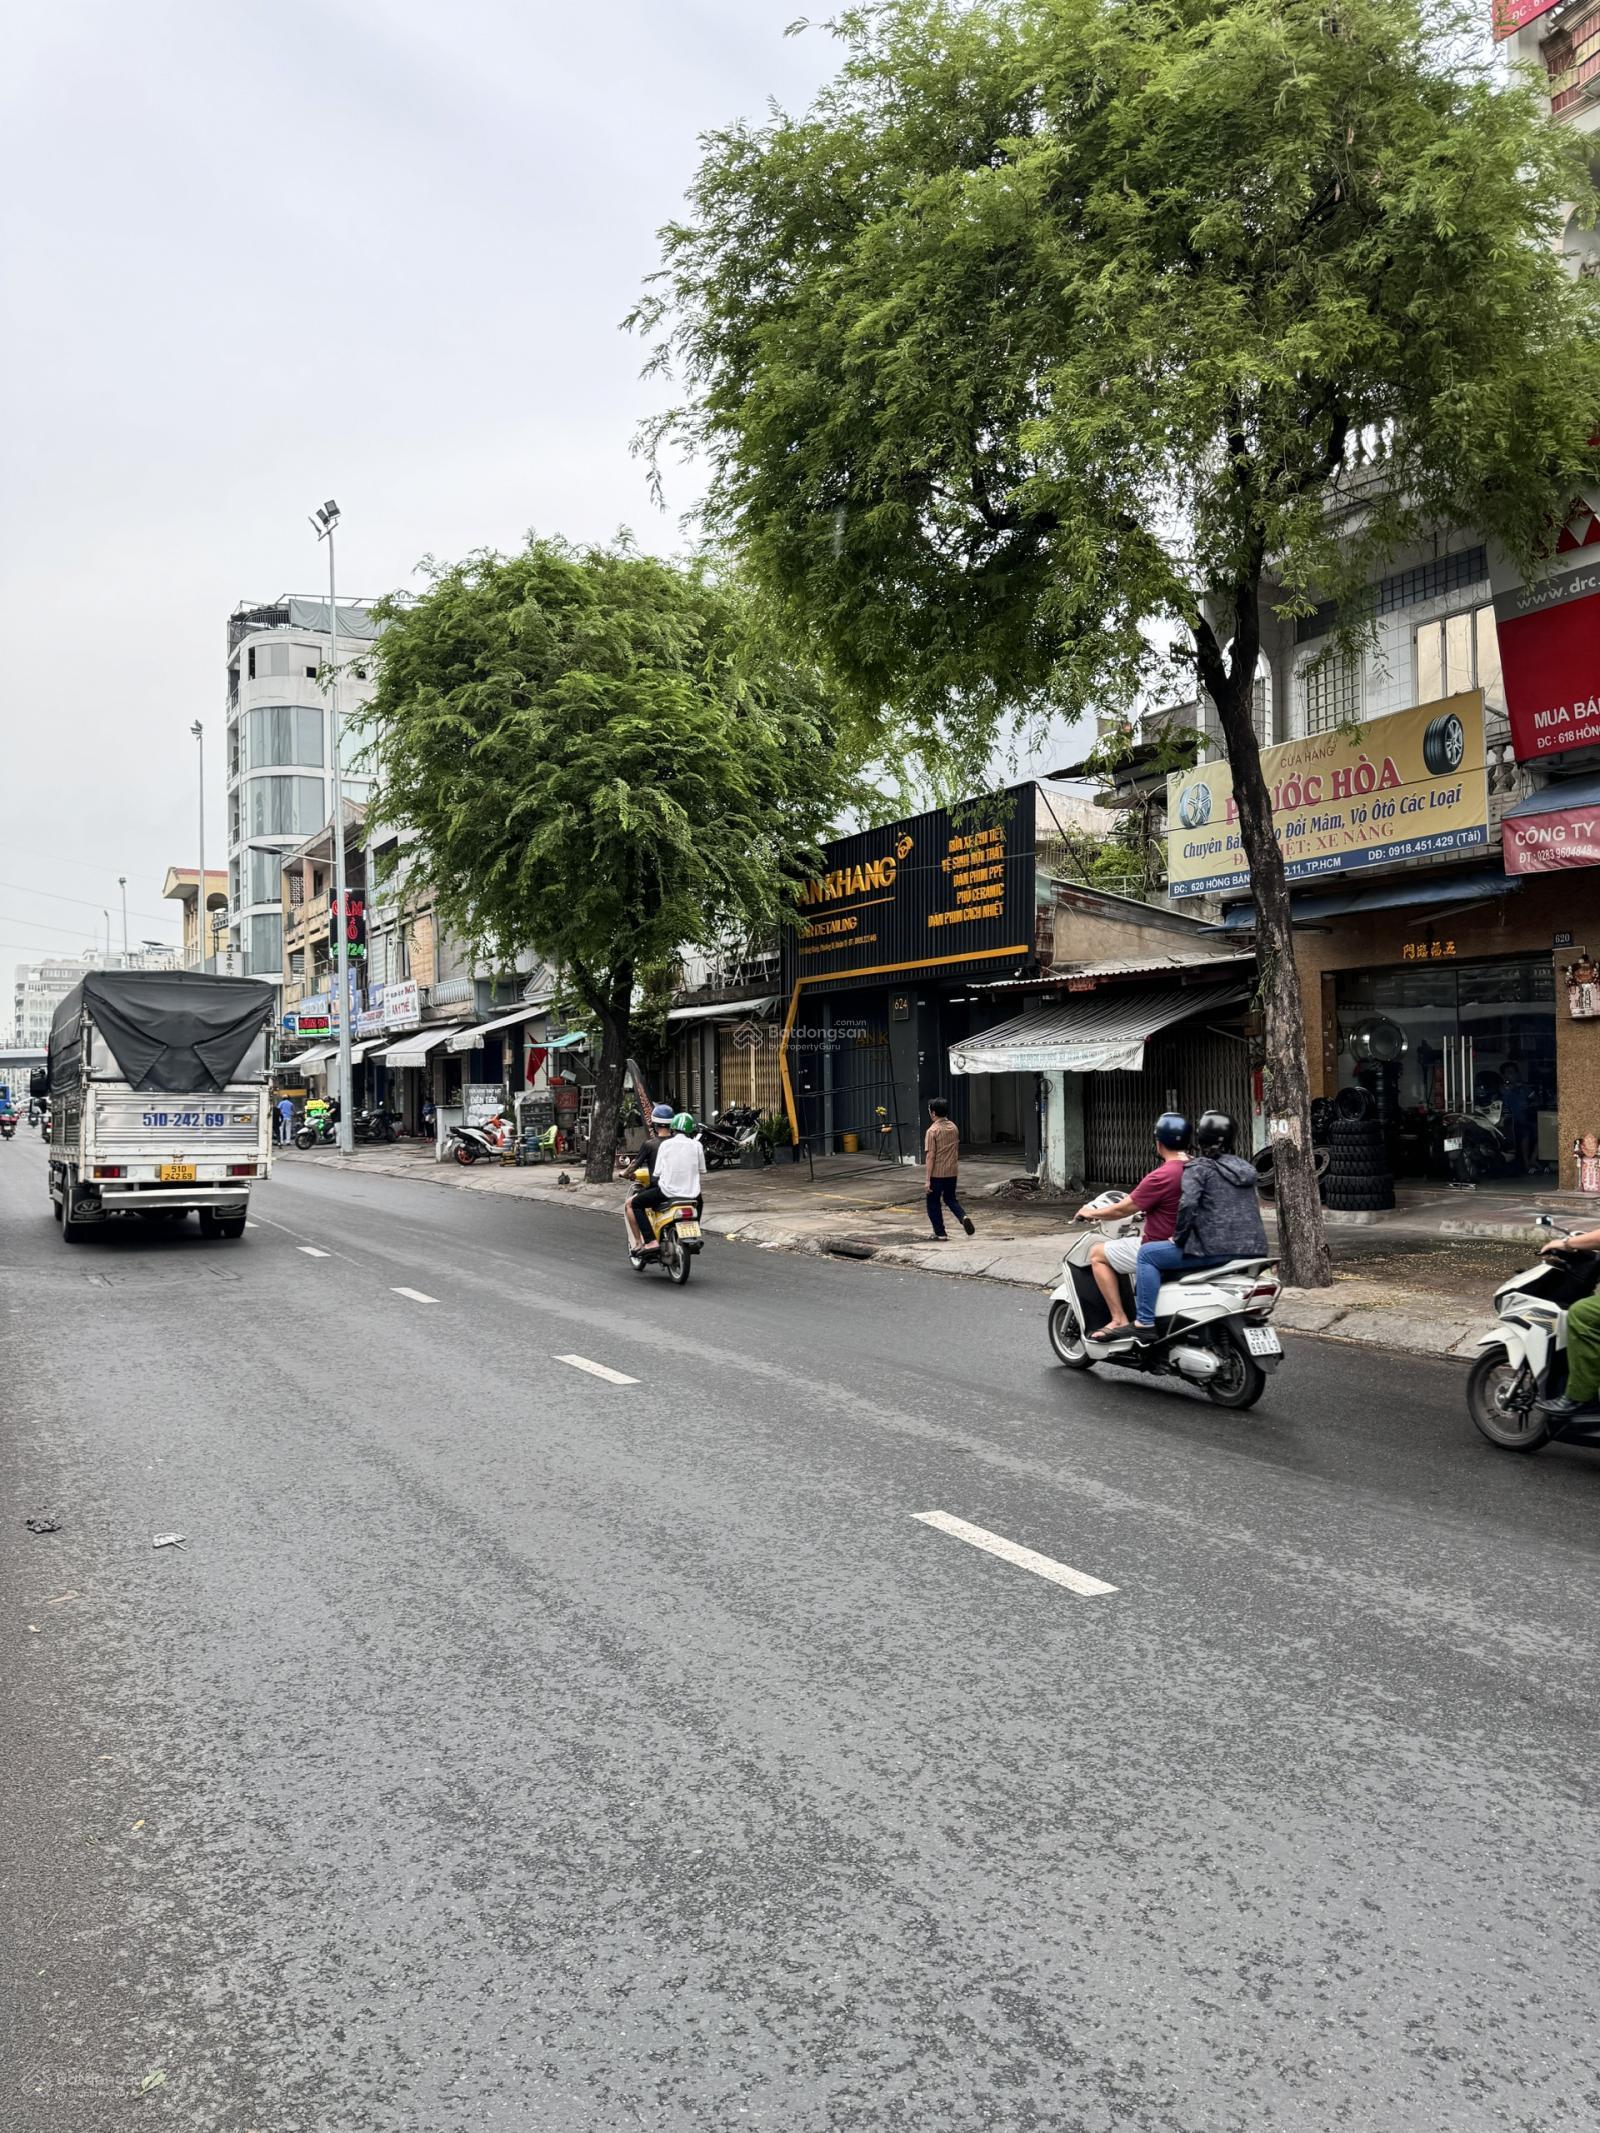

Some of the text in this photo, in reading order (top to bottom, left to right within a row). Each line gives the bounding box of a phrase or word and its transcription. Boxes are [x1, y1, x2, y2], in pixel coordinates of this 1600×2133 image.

[1534, 695, 1600, 730] MUA BÁ
[1558, 730, 1575, 744] 618
[1575, 722, 1600, 740] HỒN
[1330, 753, 1404, 799] HÒA
[1286, 813, 1306, 838] Đổi
[1310, 811, 1345, 833] Mâm,
[1351, 802, 1367, 825] Vỏ
[1372, 798, 1396, 821] Ôtô
[1399, 791, 1425, 815] Các
[1429, 782, 1463, 810] Loại
[1315, 834, 1339, 851] XE
[1343, 820, 1394, 845] NÂNG
[1515, 820, 1596, 847] CÔNG TY
[1174, 883, 1189, 894] ĐC:
[1191, 880, 1205, 892] 620
[1232, 872, 1251, 886] BÀN
[1306, 855, 1342, 872] TP.HCM
[1368, 848, 1386, 862] DĐ:
[1388, 834, 1454, 857] 0918.451.429
[1456, 829, 1481, 847] (Tài)
[1183, 836, 1223, 860] Chuyên
[1555, 932, 1571, 944] 620
[142, 1112, 225, 1127] 51D-242.69
[171, 1165, 187, 1173] 51D
